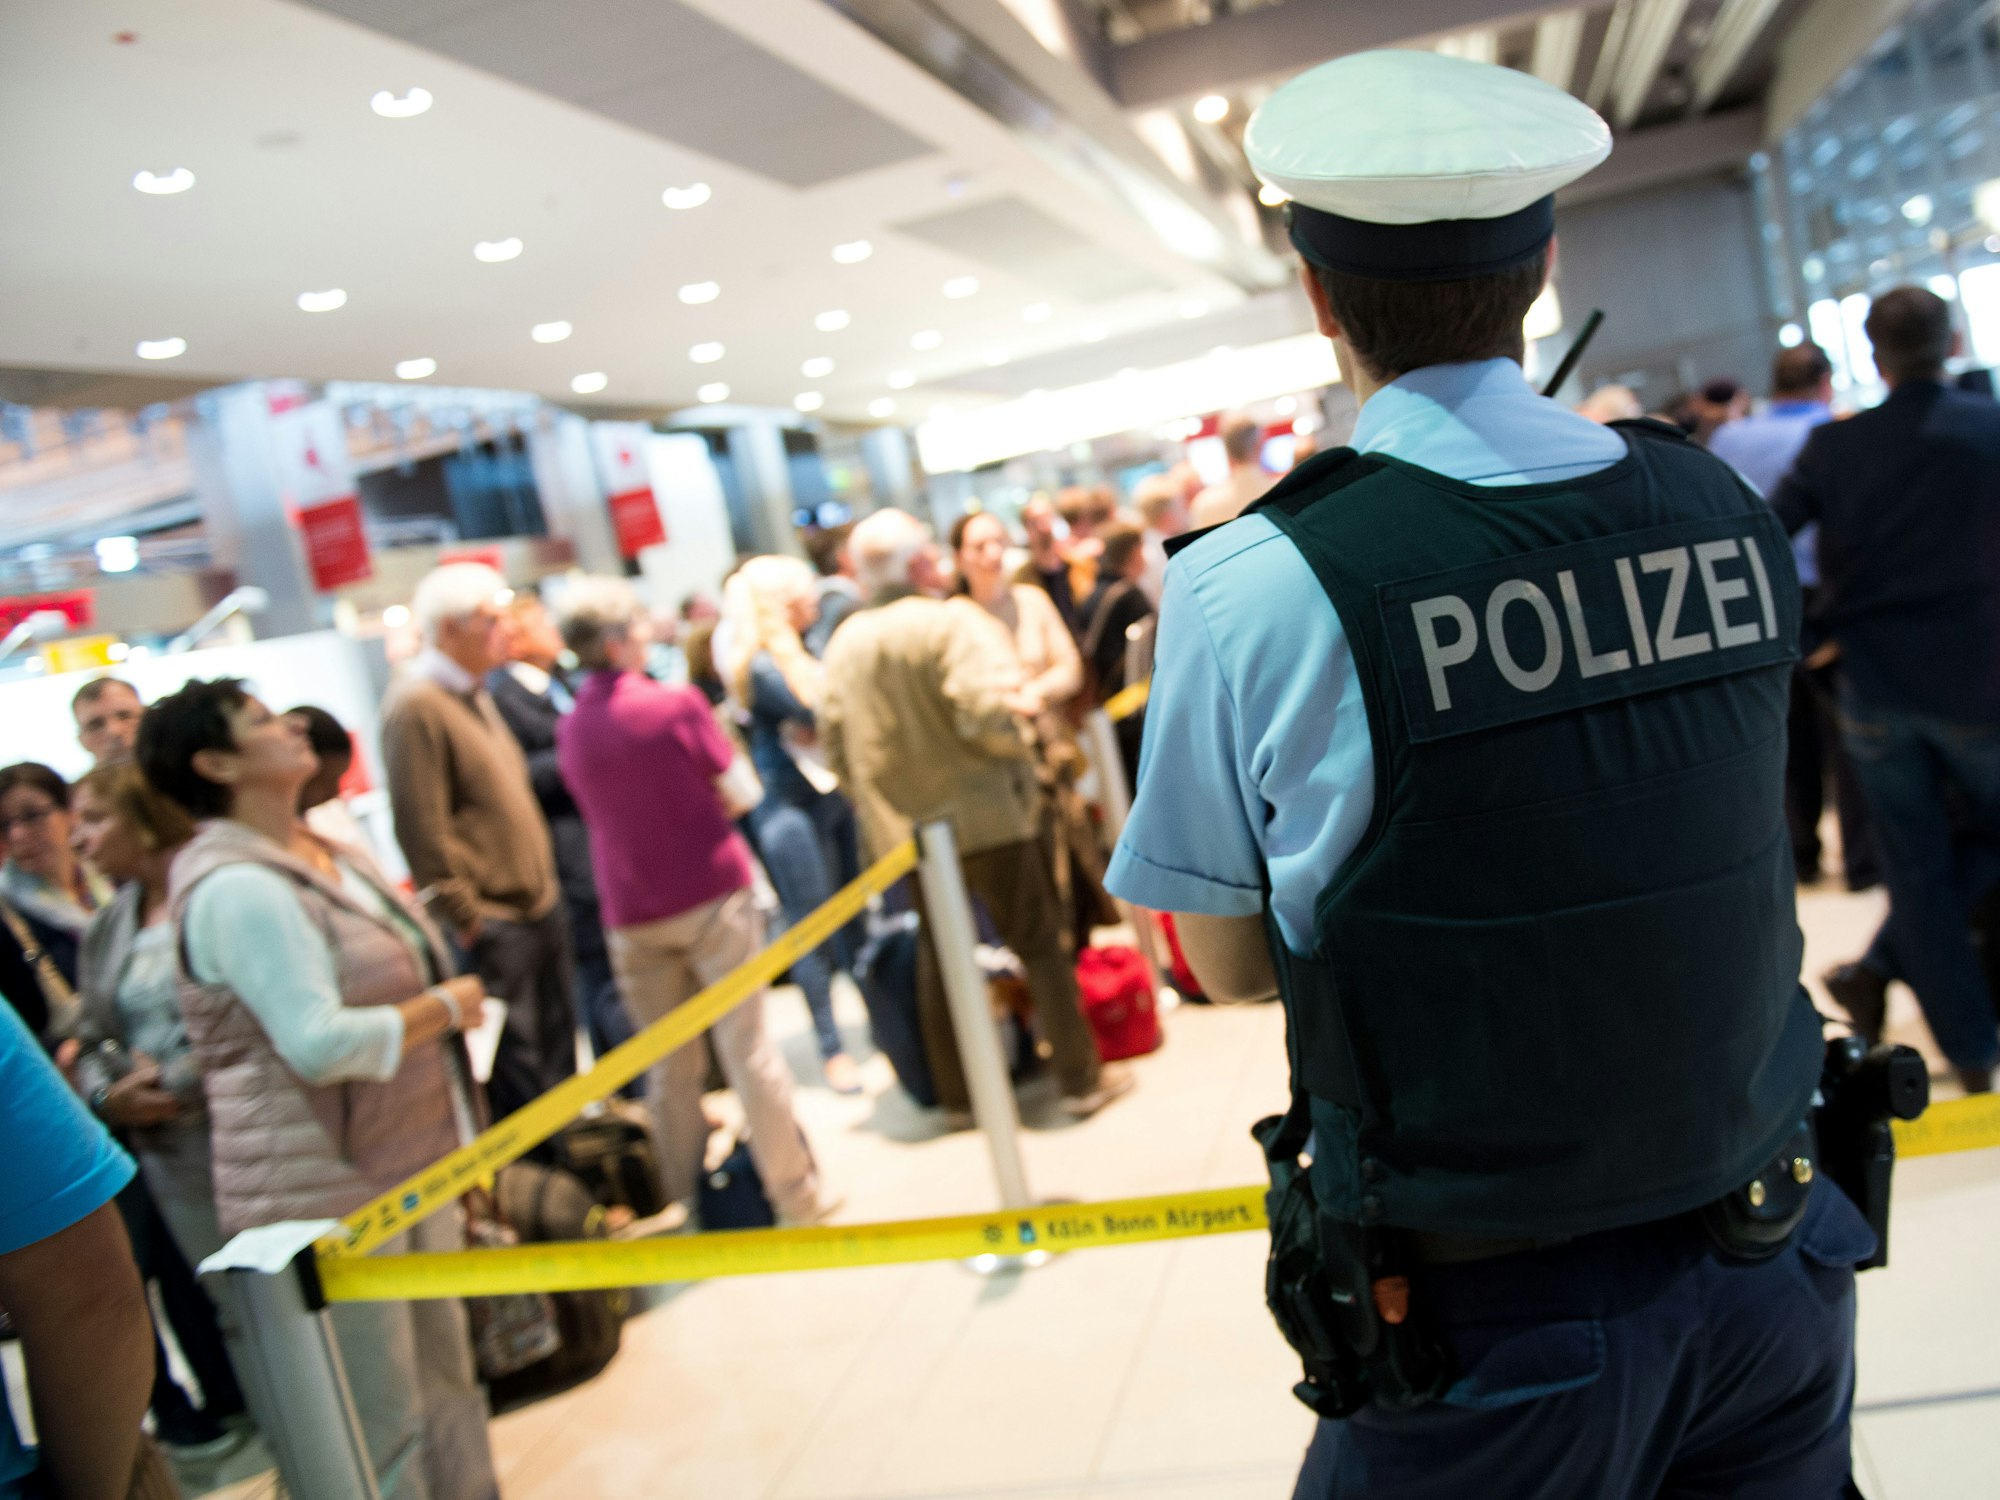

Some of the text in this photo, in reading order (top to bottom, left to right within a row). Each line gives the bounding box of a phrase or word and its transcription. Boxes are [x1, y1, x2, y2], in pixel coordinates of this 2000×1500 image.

[1411, 537, 1778, 712] POLIZEI
[1104, 1214, 1157, 1234] Bonn
[1166, 1204, 1253, 1229] Airport
